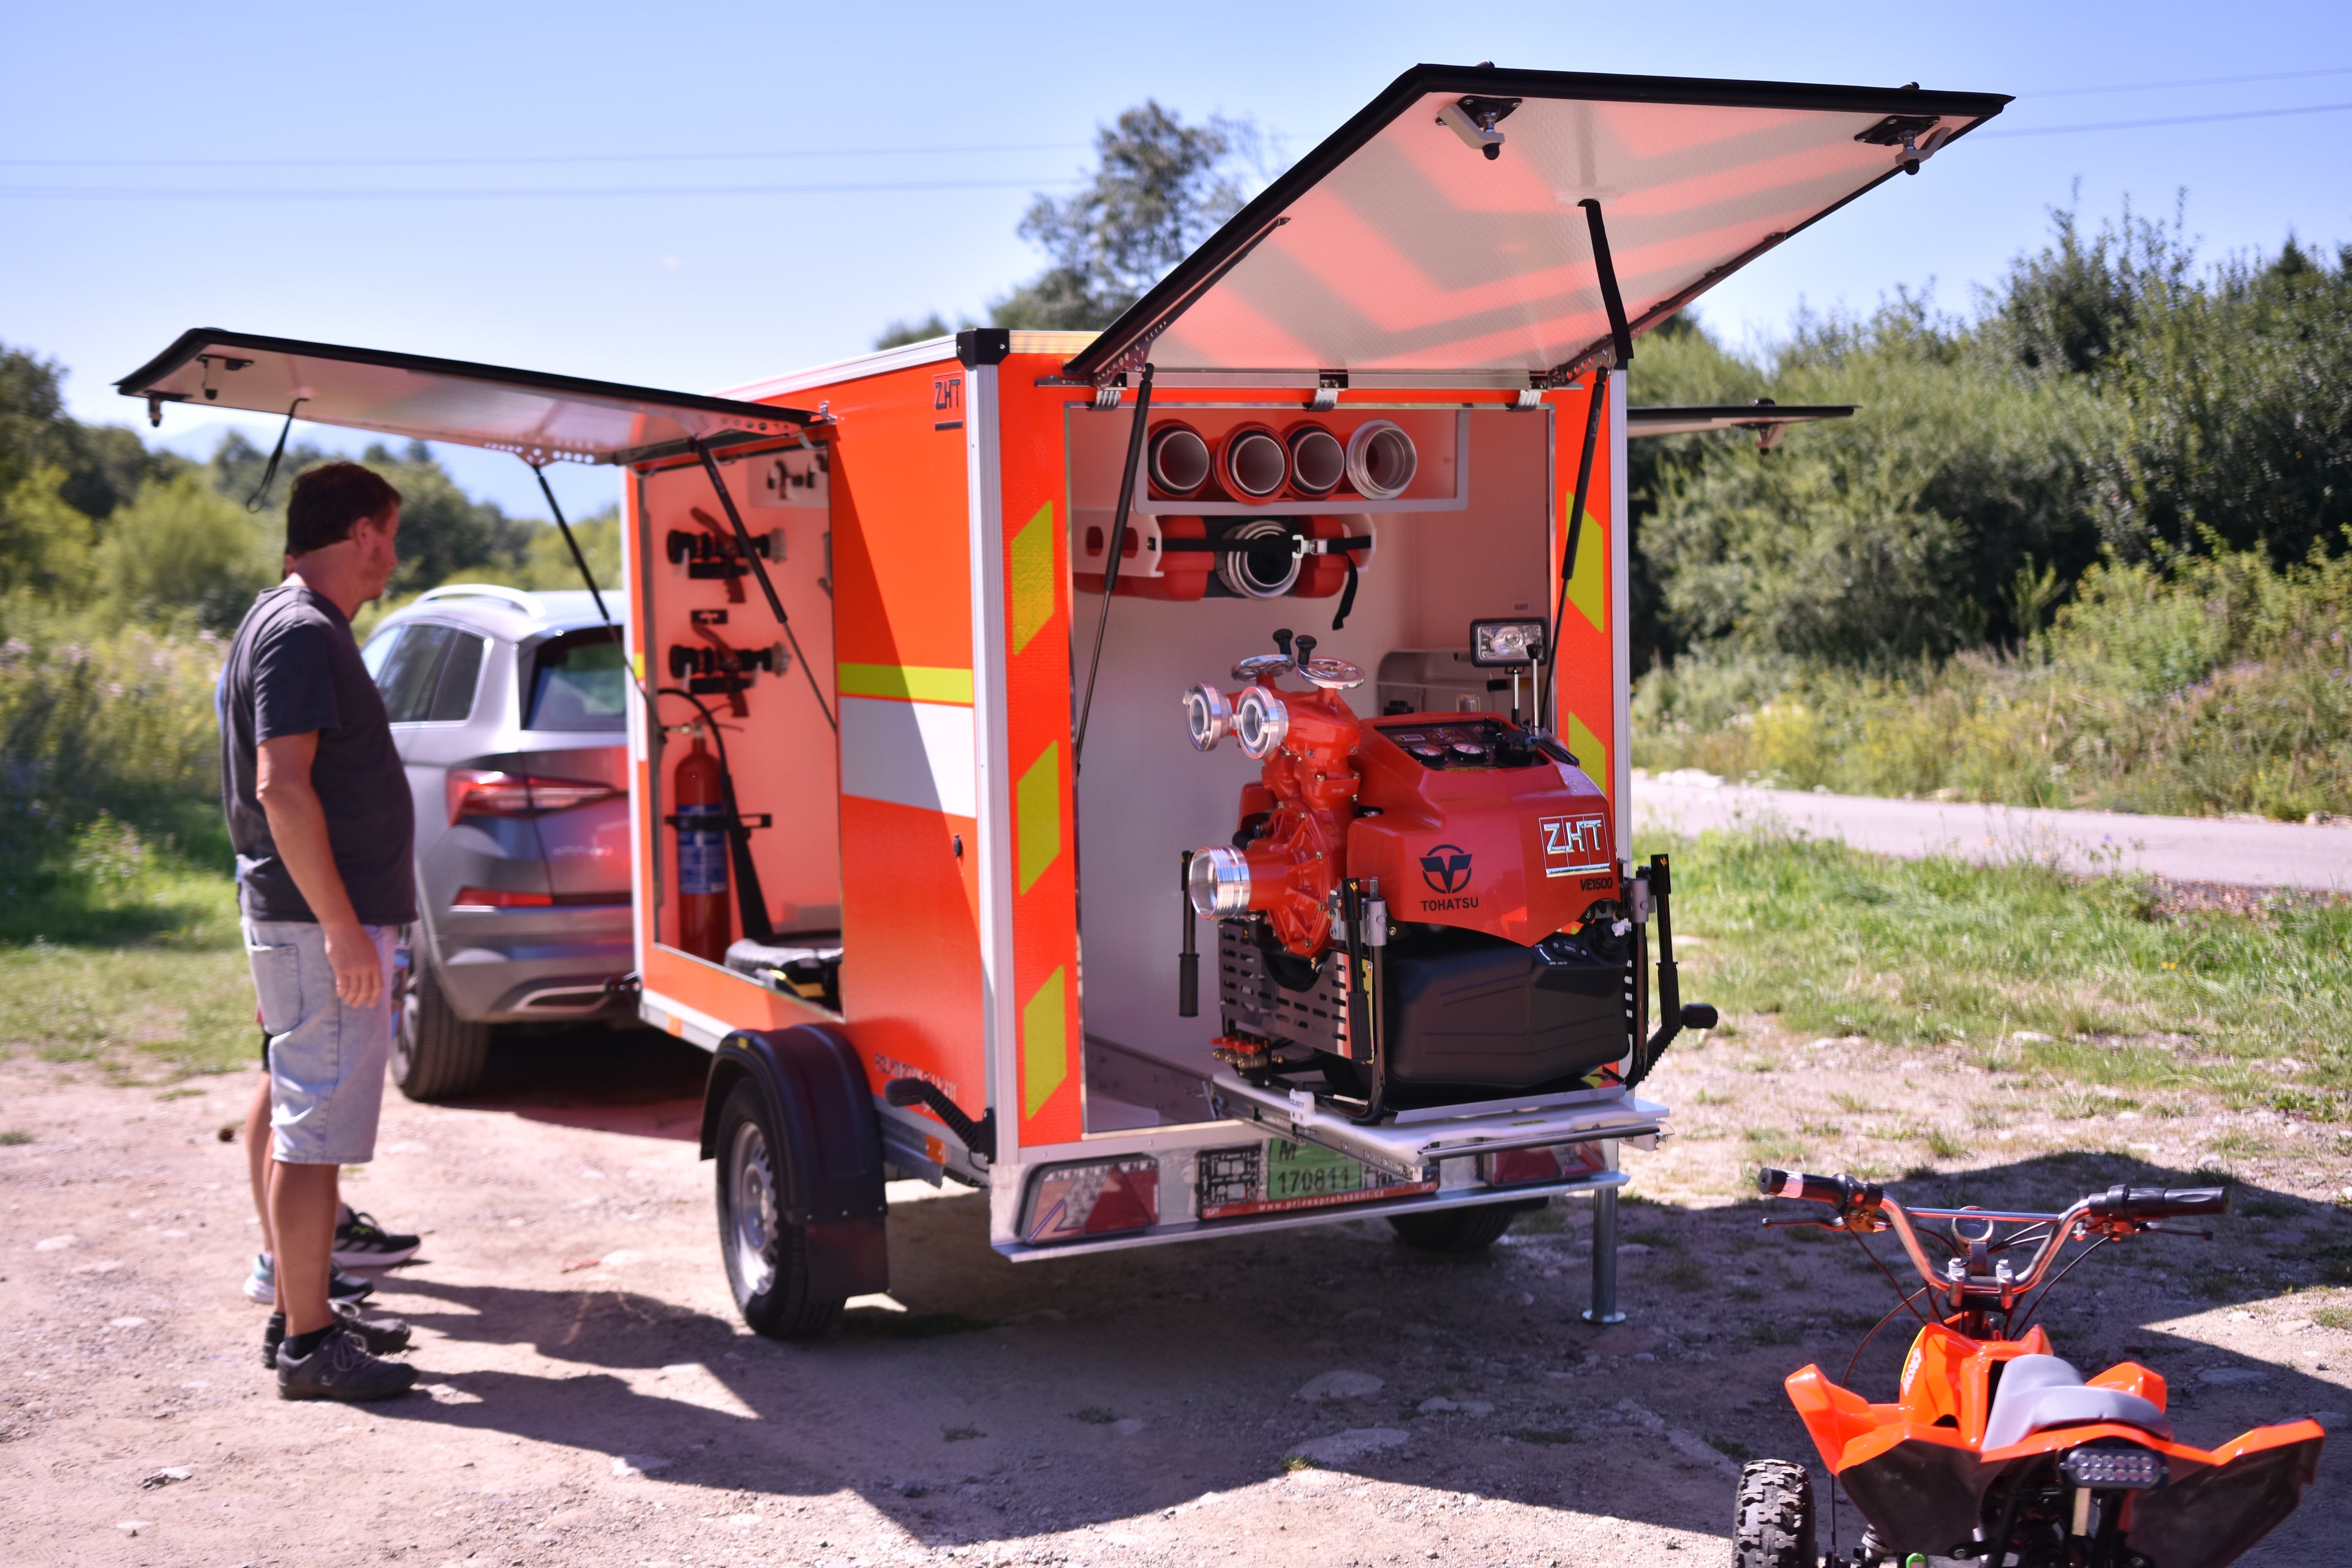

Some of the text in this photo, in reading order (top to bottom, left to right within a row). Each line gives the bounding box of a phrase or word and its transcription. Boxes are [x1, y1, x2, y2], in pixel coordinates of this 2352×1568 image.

[1544, 820, 1602, 855] ZHT
[1580, 877, 1613, 892] VE1500
[1420, 897, 1479, 912] TOHATSU
[935, 991, 960, 1022] ZHT
[1278, 1166, 1349, 1193] 170811
